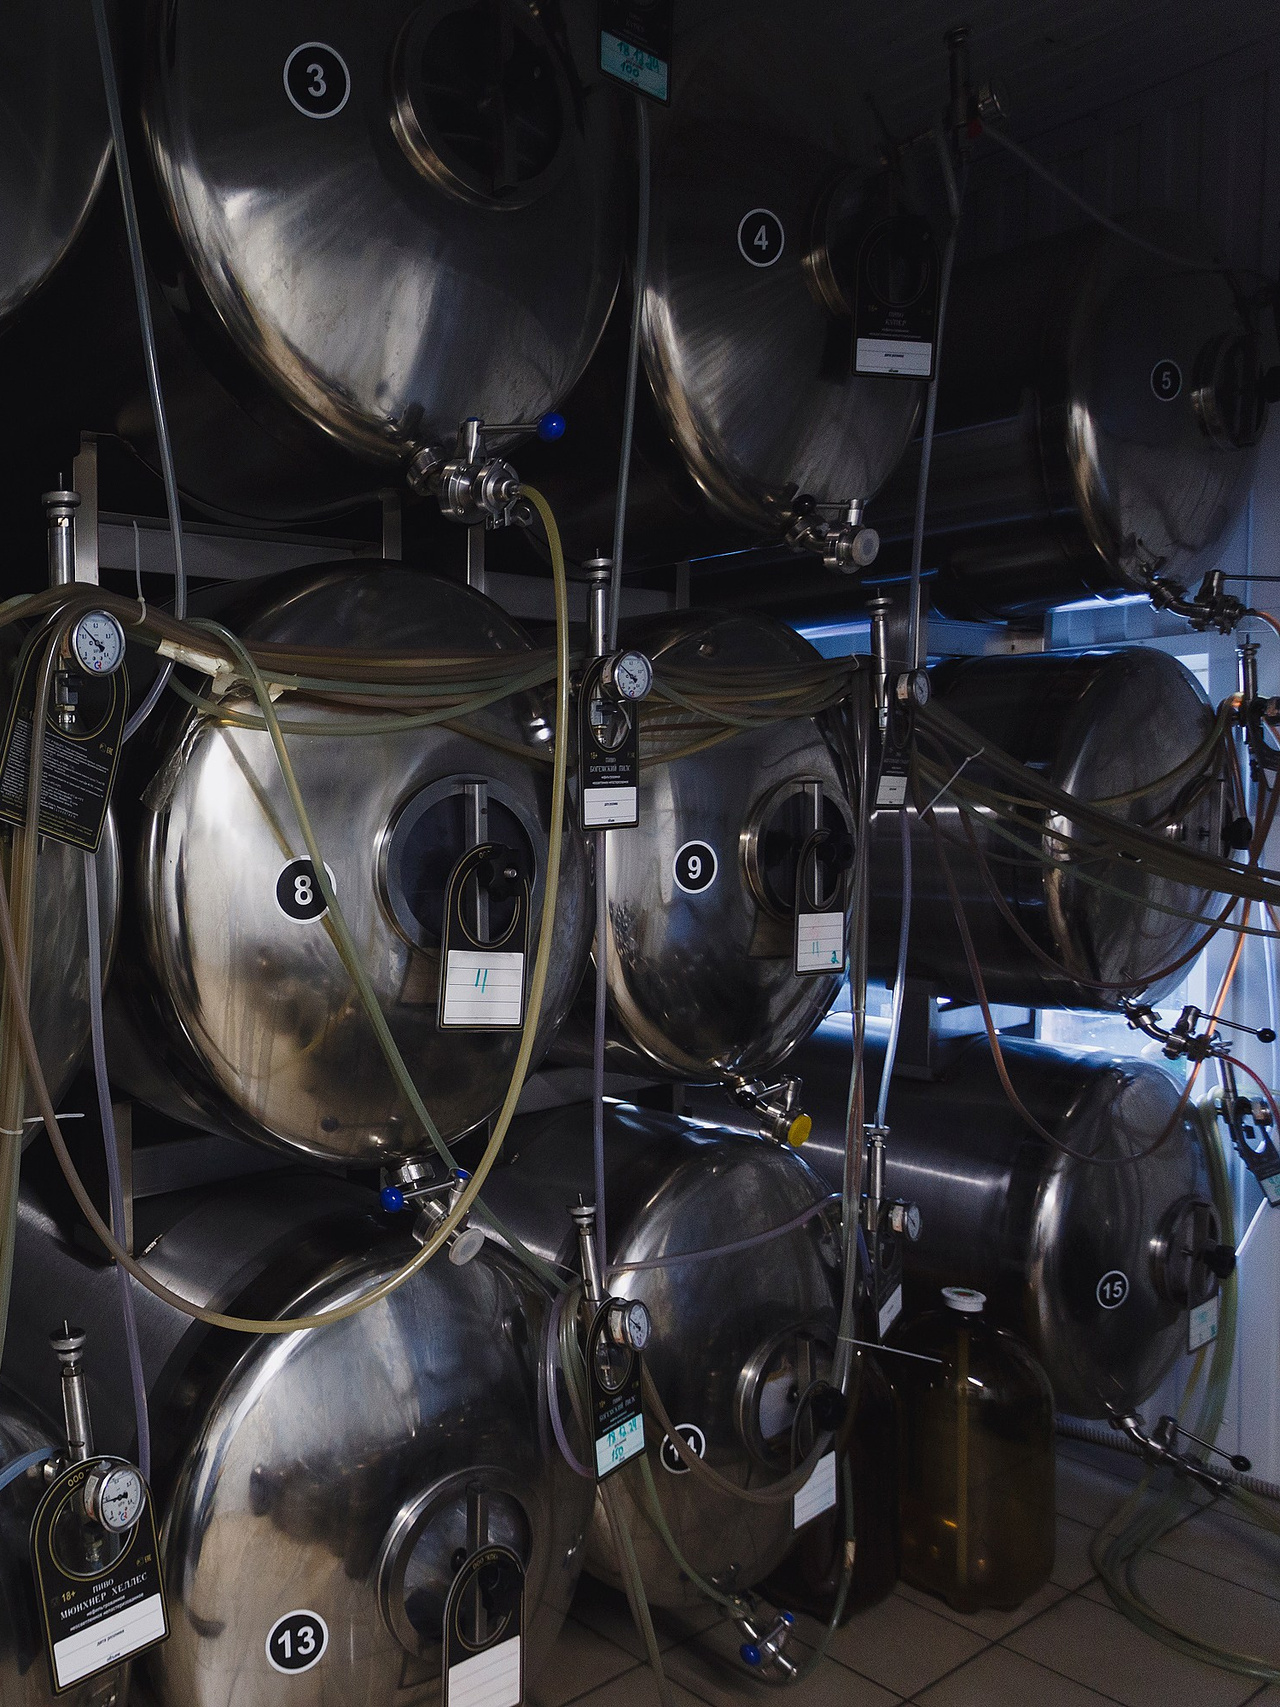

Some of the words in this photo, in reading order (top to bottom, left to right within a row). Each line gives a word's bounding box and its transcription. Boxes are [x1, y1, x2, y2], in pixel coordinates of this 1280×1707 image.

[306, 63, 327, 97] 3
[753, 225, 769, 251] 4
[1161, 371, 1172, 390] 5
[687, 855, 702, 880] 9
[294, 874, 313, 906] 8
[1102, 1280, 1123, 1299] 15
[60, 1591, 107, 1621] МЮНХНЕР
[111, 1572, 148, 1596] ХЕЛЛЕС
[61, 1590, 77, 1603] 18+
[92, 1578, 115, 1594] ПИВО
[277, 1625, 316, 1659] 13
